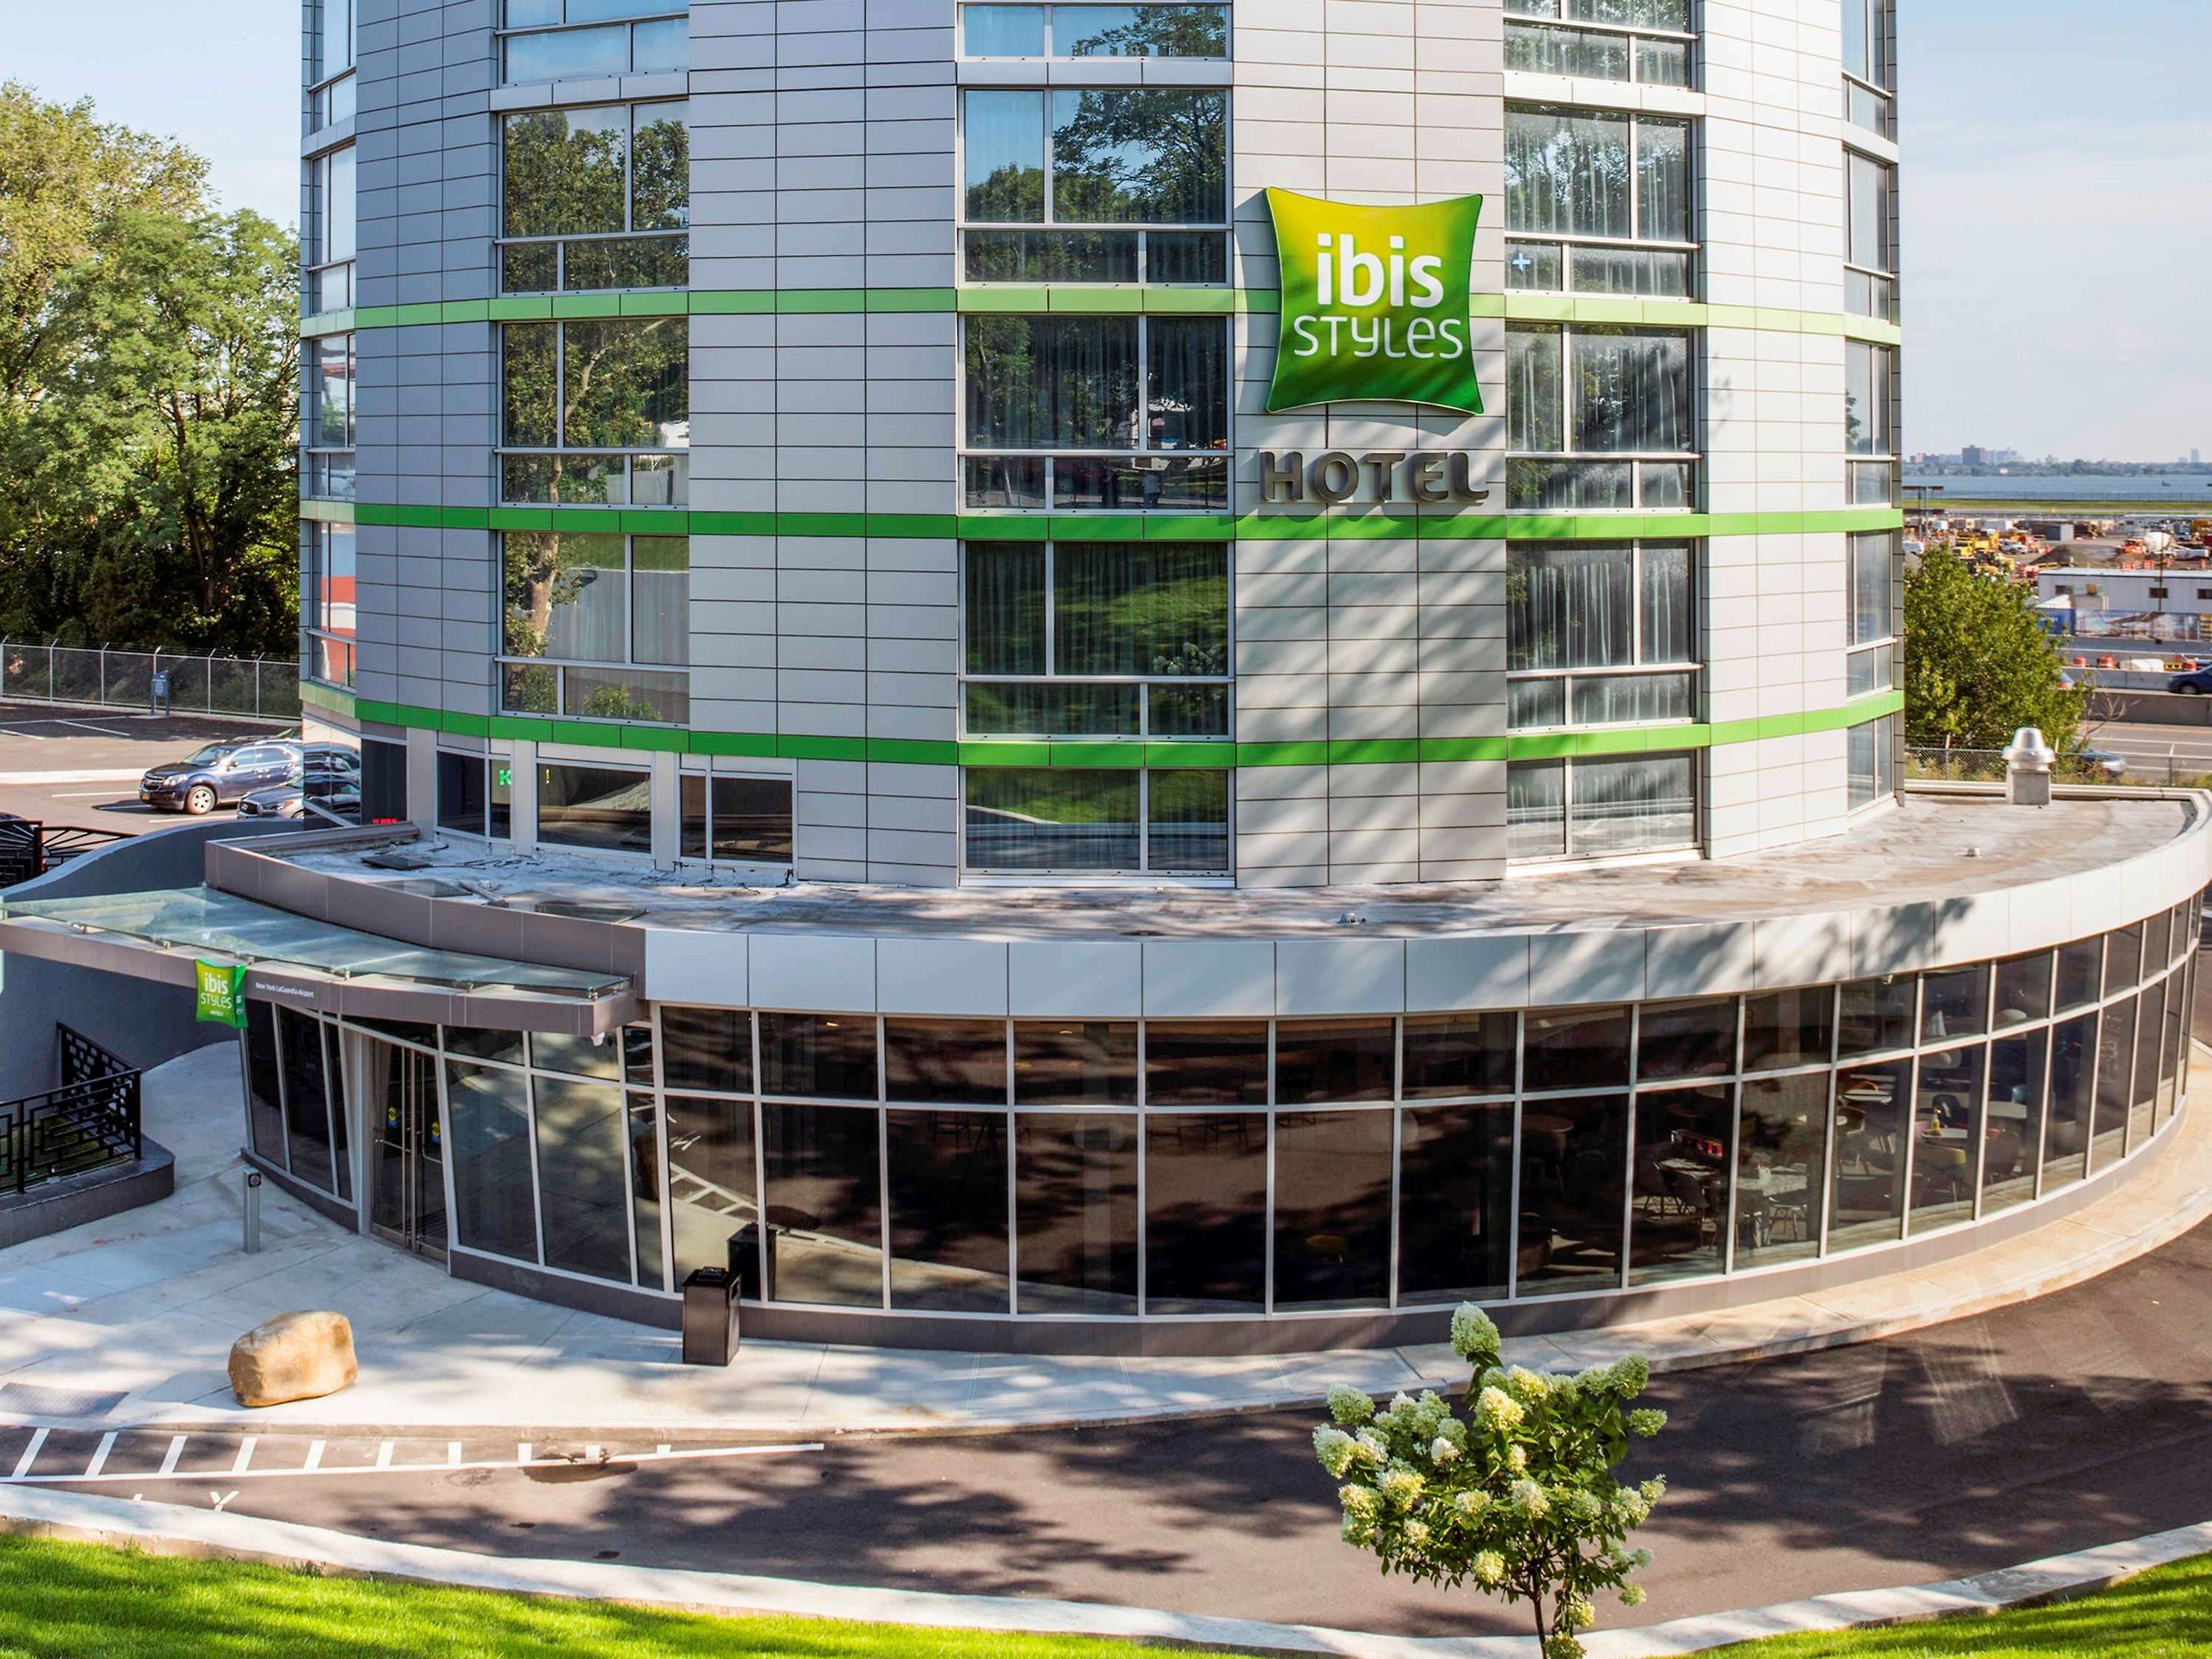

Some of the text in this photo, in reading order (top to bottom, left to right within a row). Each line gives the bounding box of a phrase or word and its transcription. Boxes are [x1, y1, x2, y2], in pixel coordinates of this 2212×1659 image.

[1317, 233, 1444, 307] ibis
[1260, 452, 1489, 502] HOTEL
[205, 972, 228, 995] ibis
